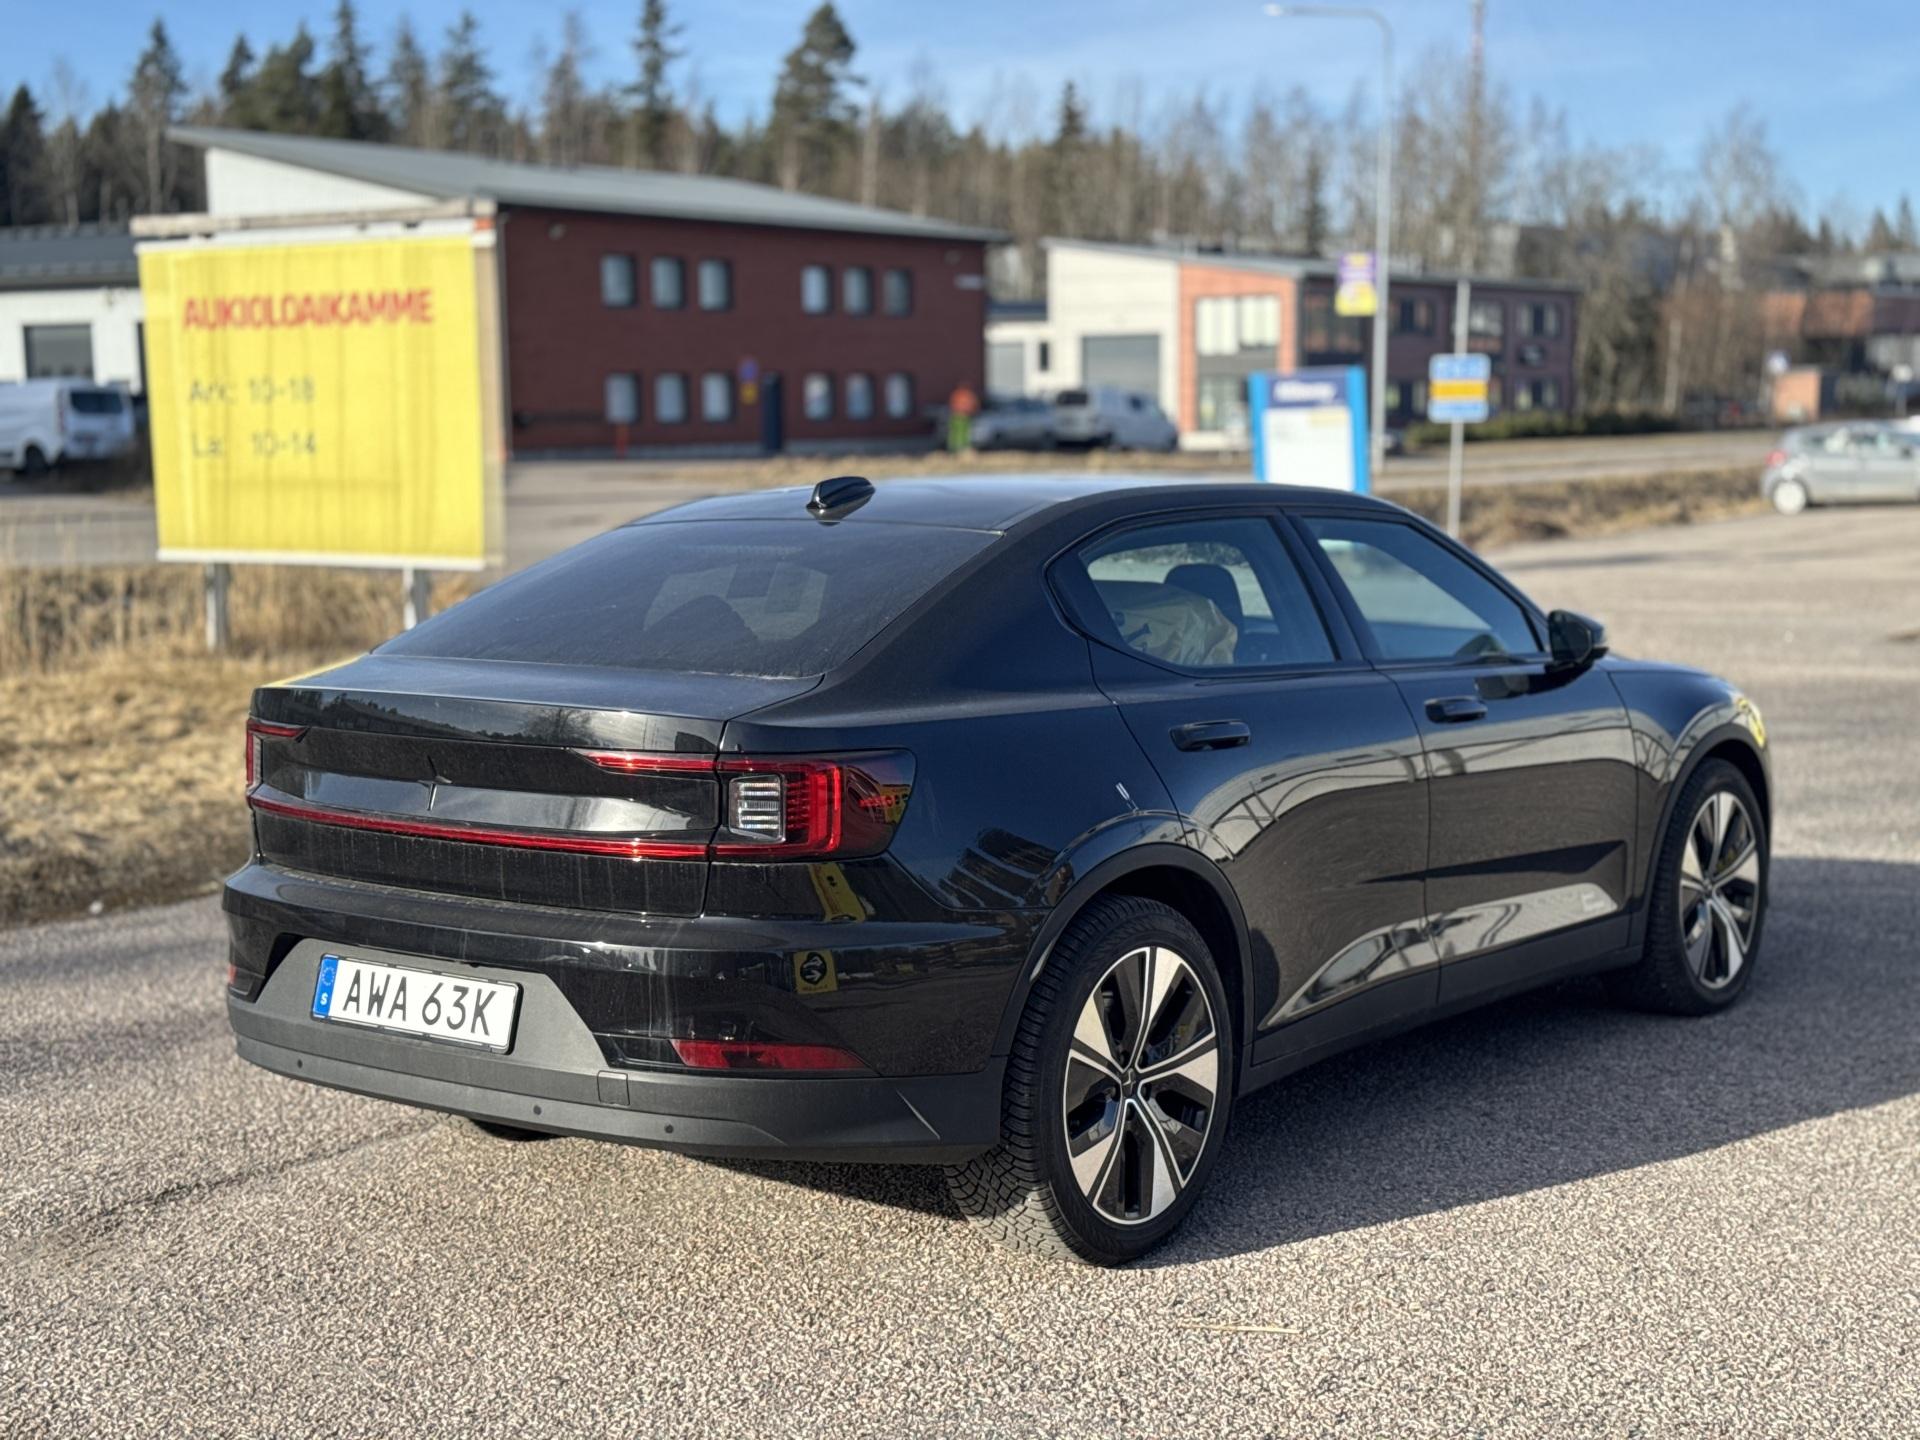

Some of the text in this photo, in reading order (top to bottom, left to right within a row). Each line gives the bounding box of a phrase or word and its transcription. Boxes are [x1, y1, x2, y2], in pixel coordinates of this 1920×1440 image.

[320, 992, 329, 1005] S
[342, 968, 497, 1036] AWA 63K
